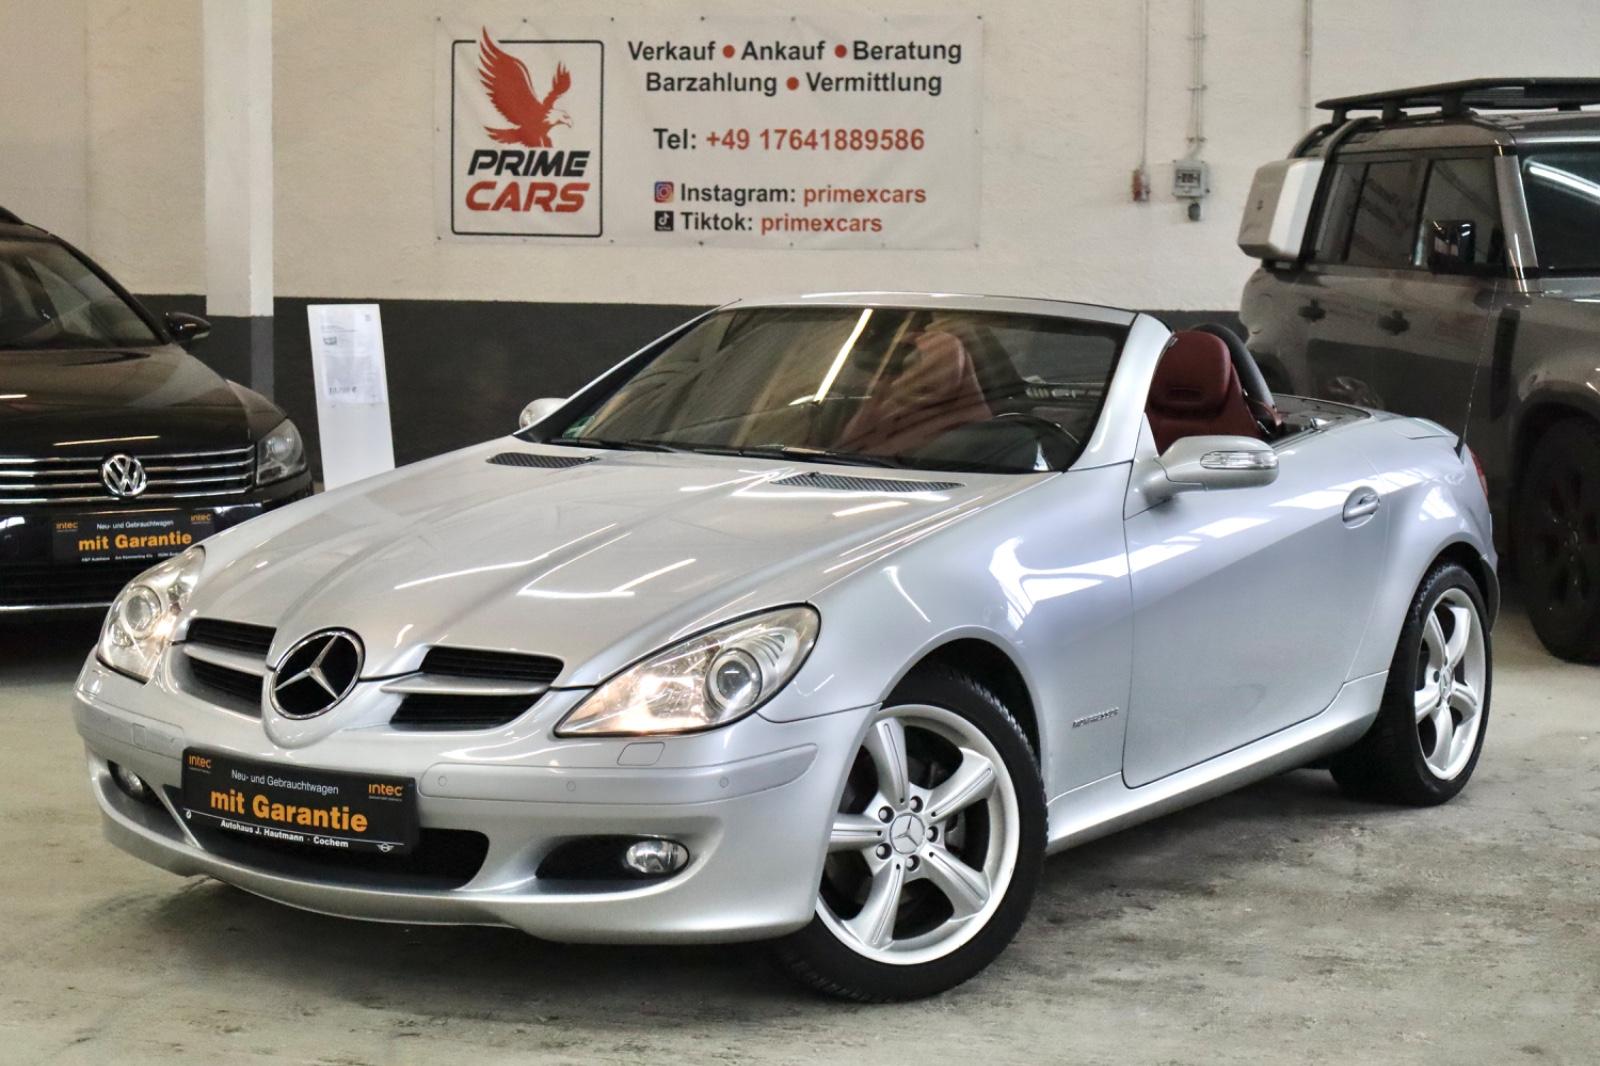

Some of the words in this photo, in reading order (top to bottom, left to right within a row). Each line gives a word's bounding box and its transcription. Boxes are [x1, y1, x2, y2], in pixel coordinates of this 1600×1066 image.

[628, 40, 716, 60] Verkauf
[741, 40, 826, 60] Ankauf
[853, 40, 962, 64] Beratung
[646, 72, 777, 96] Barzahlung
[806, 72, 942, 96] Vermittlung
[653, 128, 697, 150] Tel:
[706, 128, 750, 150] +49
[760, 128, 925, 150] 17641889586
[467, 149, 590, 177] PRIME
[465, 181, 591, 212] CARS
[680, 183, 796, 206] Instagram:
[804, 184, 926, 206] primexcars
[680, 211, 753, 231] Tiktok:
[761, 213, 882, 235] primexcars
[125, 519, 174, 529] Gebrauchtwagen
[78, 536, 109, 551] mit
[115, 530, 192, 549] Garantie
[231, 769, 249, 782] Neu-
[250, 774, 266, 786] und
[267, 776, 339, 795] Gebrauchtwagen
[369, 783, 403, 797] intec
[210, 788, 246, 815] mit
[252, 794, 368, 832] Garantie
[220, 819, 254, 834] Autohaus
[255, 826, 262, 835] J.
[264, 828, 304, 843] Hautmann
[313, 836, 349, 848] Cochem
